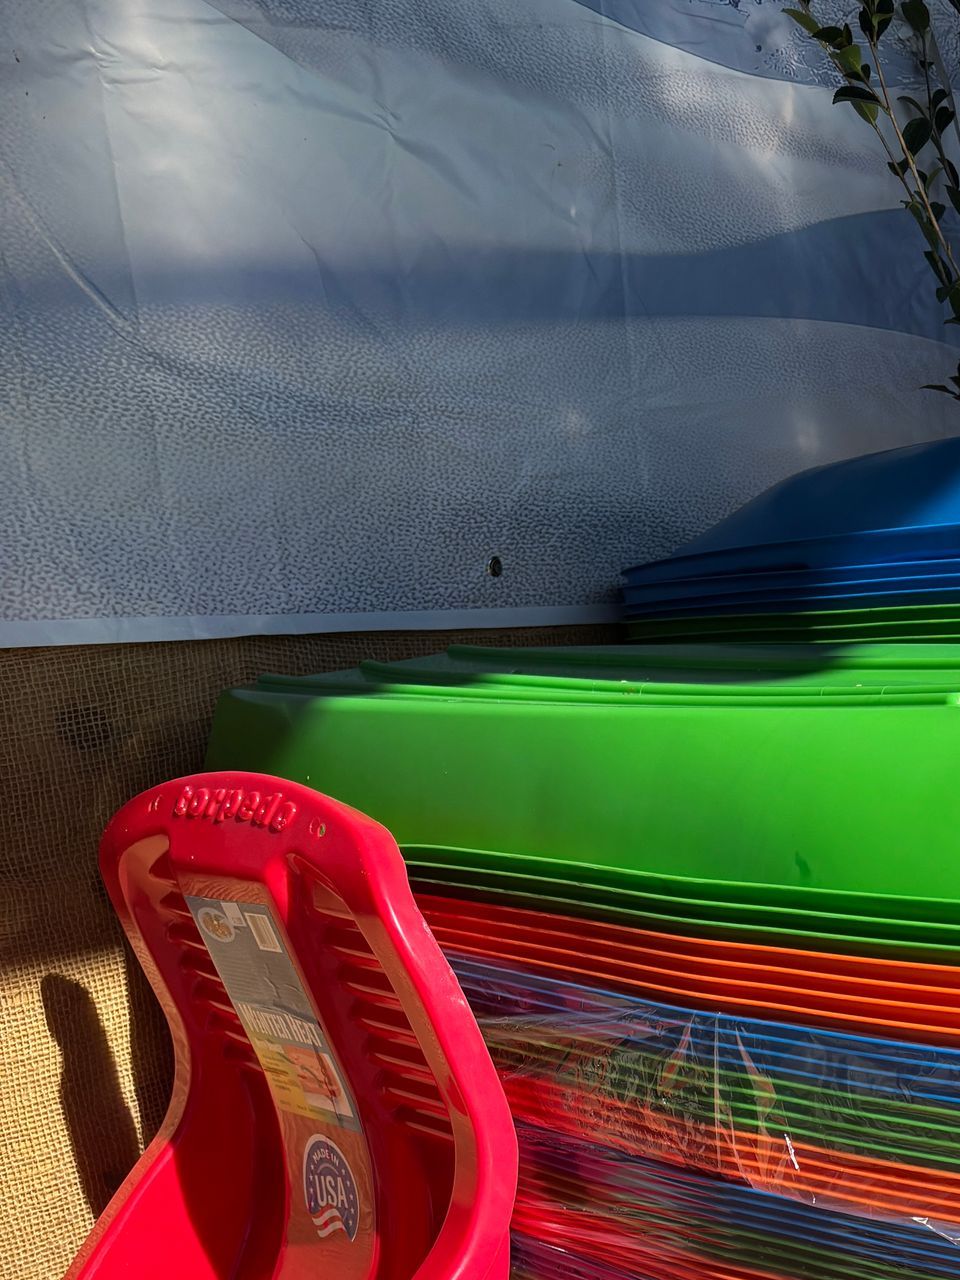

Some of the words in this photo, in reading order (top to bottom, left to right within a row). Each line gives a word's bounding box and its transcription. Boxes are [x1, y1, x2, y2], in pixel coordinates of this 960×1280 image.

[173, 785, 297, 832] torpedo
[312, 1148, 330, 1164] MADE
[331, 1154, 340, 1167] IN
[315, 1174, 349, 1209] USA
